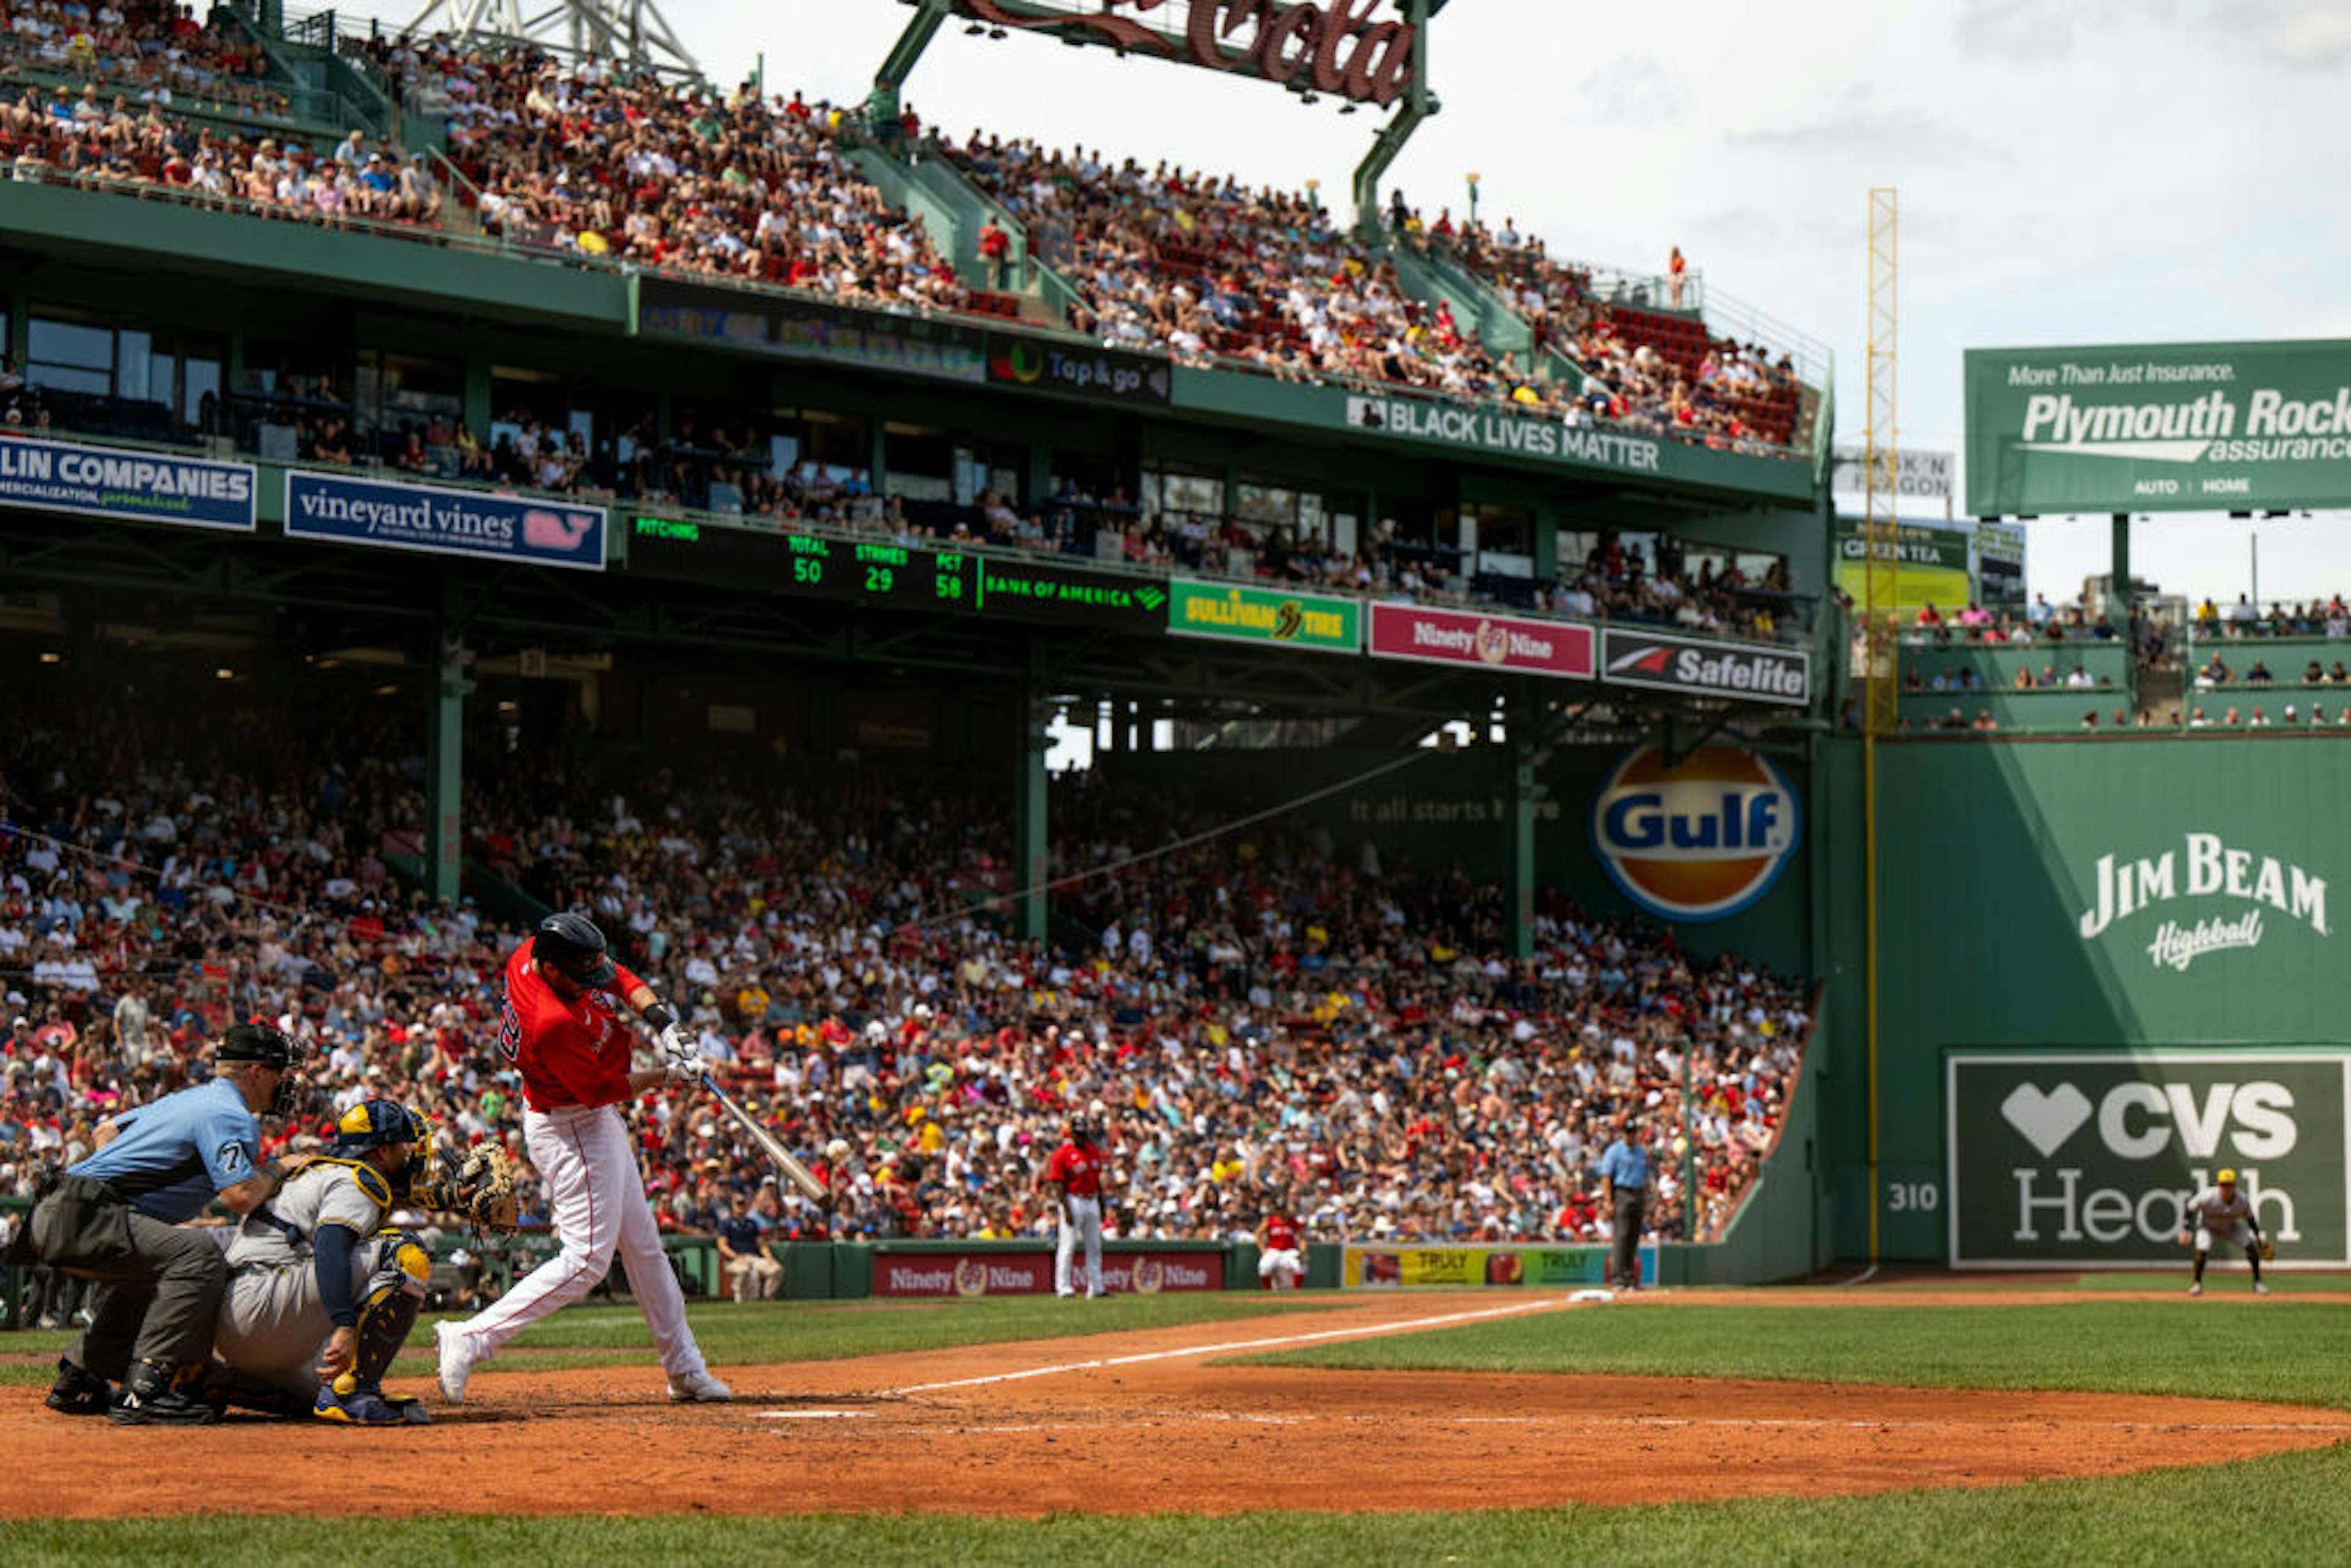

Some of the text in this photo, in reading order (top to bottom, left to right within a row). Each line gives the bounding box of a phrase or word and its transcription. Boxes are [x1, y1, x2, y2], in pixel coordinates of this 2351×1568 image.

[2008, 363, 2236, 386] More Than Just Insurance.
[1391, 403, 1659, 470] BLACK LIVES MATTER
[2022, 390, 2235, 445] Plymouth
[2208, 437, 2351, 462] assuranc
[59, 453, 250, 501] COMPANIES
[2134, 478, 2250, 495] AUTO HOME
[300, 489, 431, 533] vineyard
[437, 505, 514, 539] vines
[636, 517, 700, 541] PITCHING
[788, 535, 830, 557] TOTAL
[1910, 544, 1941, 564] TEA
[793, 558, 962, 599] 50 29 58
[985, 575, 1132, 607] BANK OF AMERICA
[1186, 588, 1343, 638] SULLIVAN TIRE
[1414, 621, 1553, 660] Ninety Nine
[1676, 648, 1804, 695] Safelite
[1604, 791, 1779, 849] Gulf
[2080, 833, 2327, 939] JIM BEAM
[2147, 908, 2264, 971] Highball
[2098, 1081, 2297, 1159] CVS
[1888, 1183, 1938, 1210] 310
[2013, 1168, 2300, 1242] Heah
[890, 1267, 1034, 1292] Ninety Nine
[1073, 1266, 1207, 1291] Nety Nine
[1418, 1252, 1467, 1269] TRULY
[1542, 1251, 1587, 1269] TRULY
